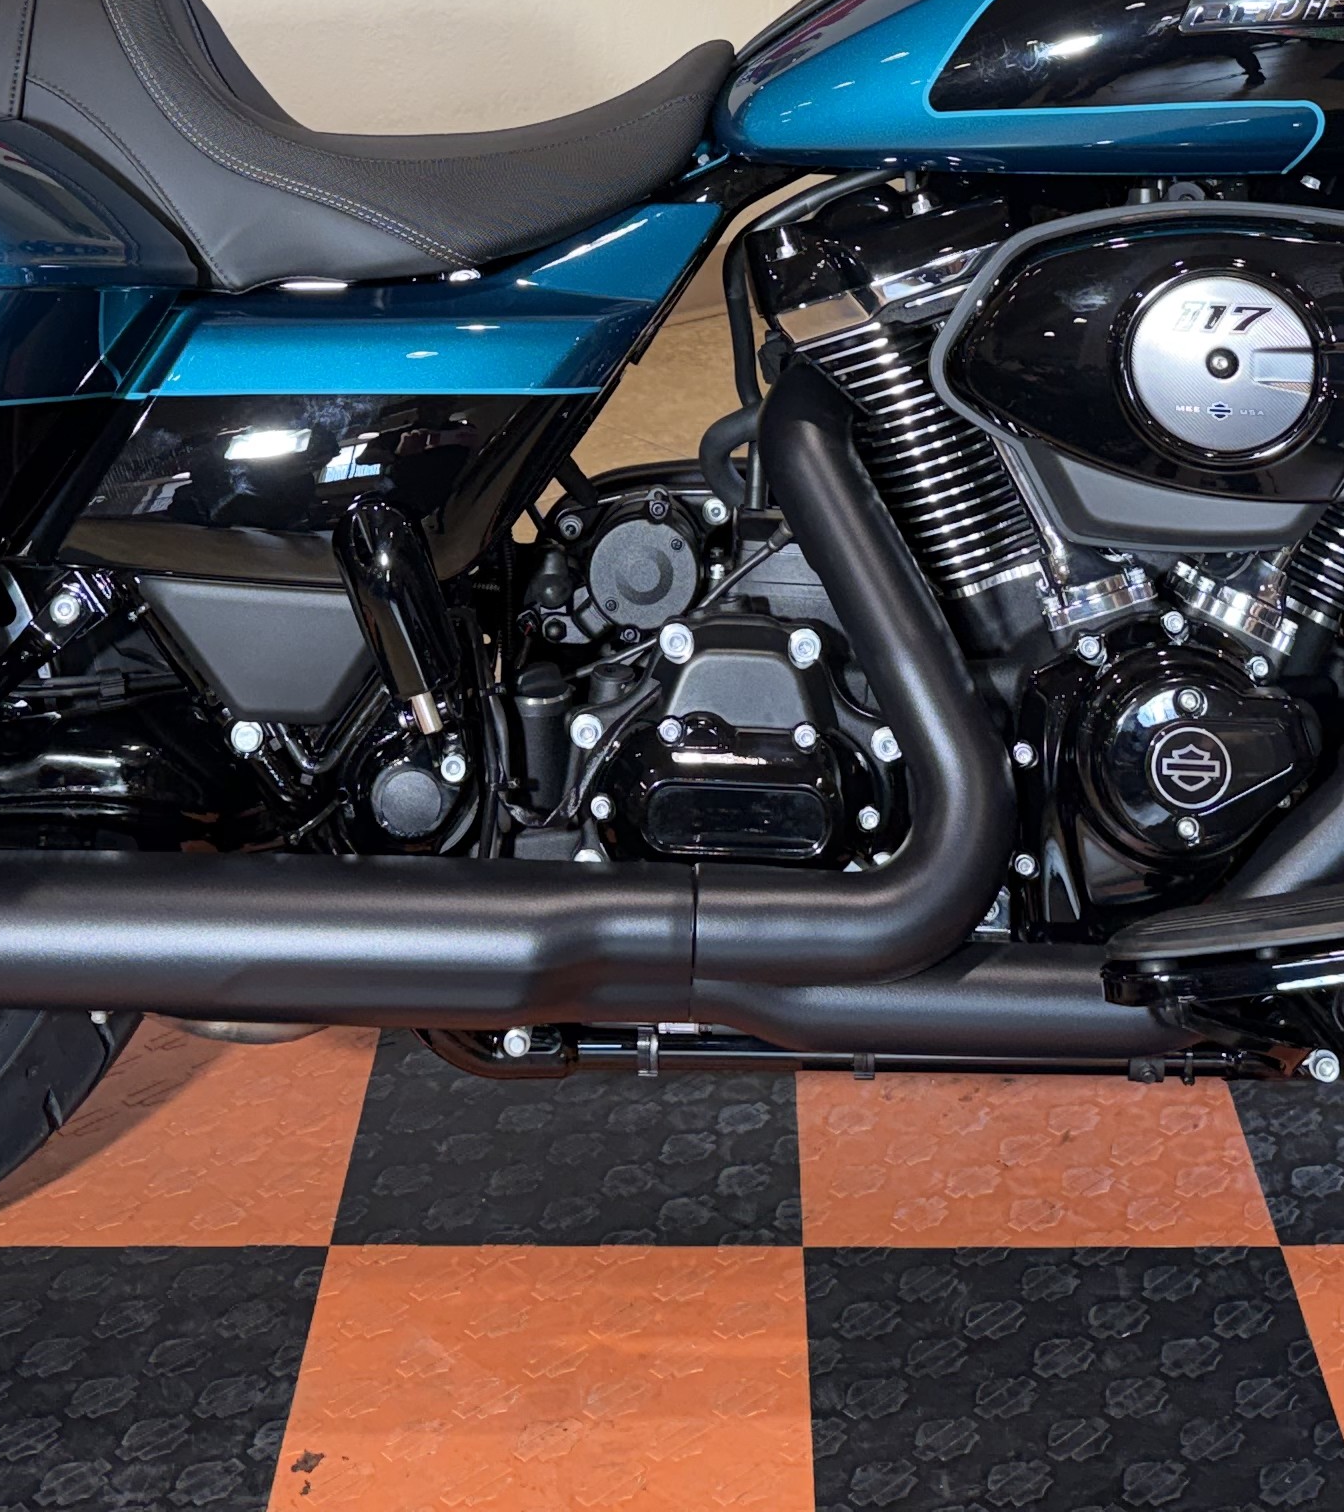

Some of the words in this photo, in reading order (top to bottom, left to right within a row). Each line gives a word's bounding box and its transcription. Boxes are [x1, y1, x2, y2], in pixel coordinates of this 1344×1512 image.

[1173, 300, 1276, 335] 117
[1175, 404, 1201, 414] MKE
[1239, 409, 1265, 417] USA
